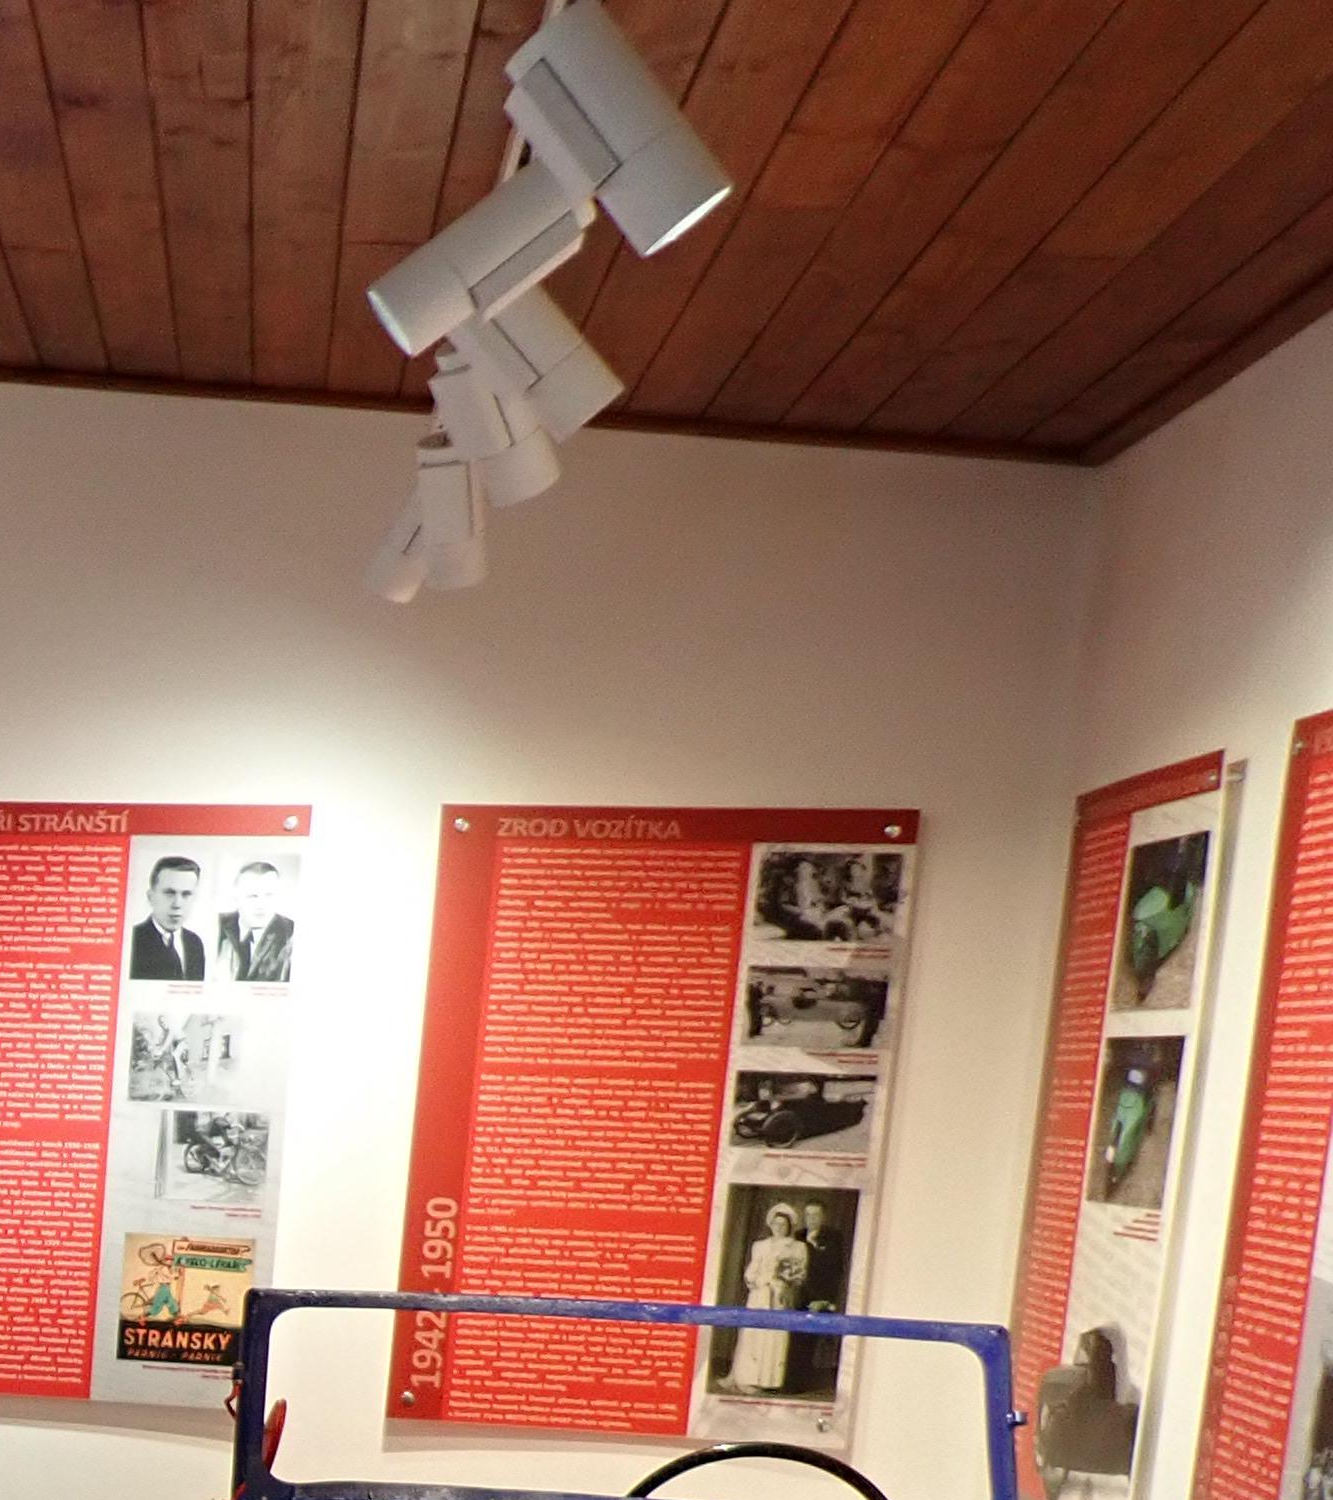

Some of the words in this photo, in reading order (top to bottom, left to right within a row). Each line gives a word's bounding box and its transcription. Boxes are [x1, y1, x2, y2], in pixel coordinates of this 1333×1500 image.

[18, 809, 128, 832] STRÁNŠTÍ
[496, 817, 569, 838] ZROD
[574, 815, 682, 839] VOZÍTKA
[421, 1196, 458, 1280] 1950
[124, 1325, 232, 1351] STRÁNSKÝ
[410, 1310, 448, 1388] 1942
